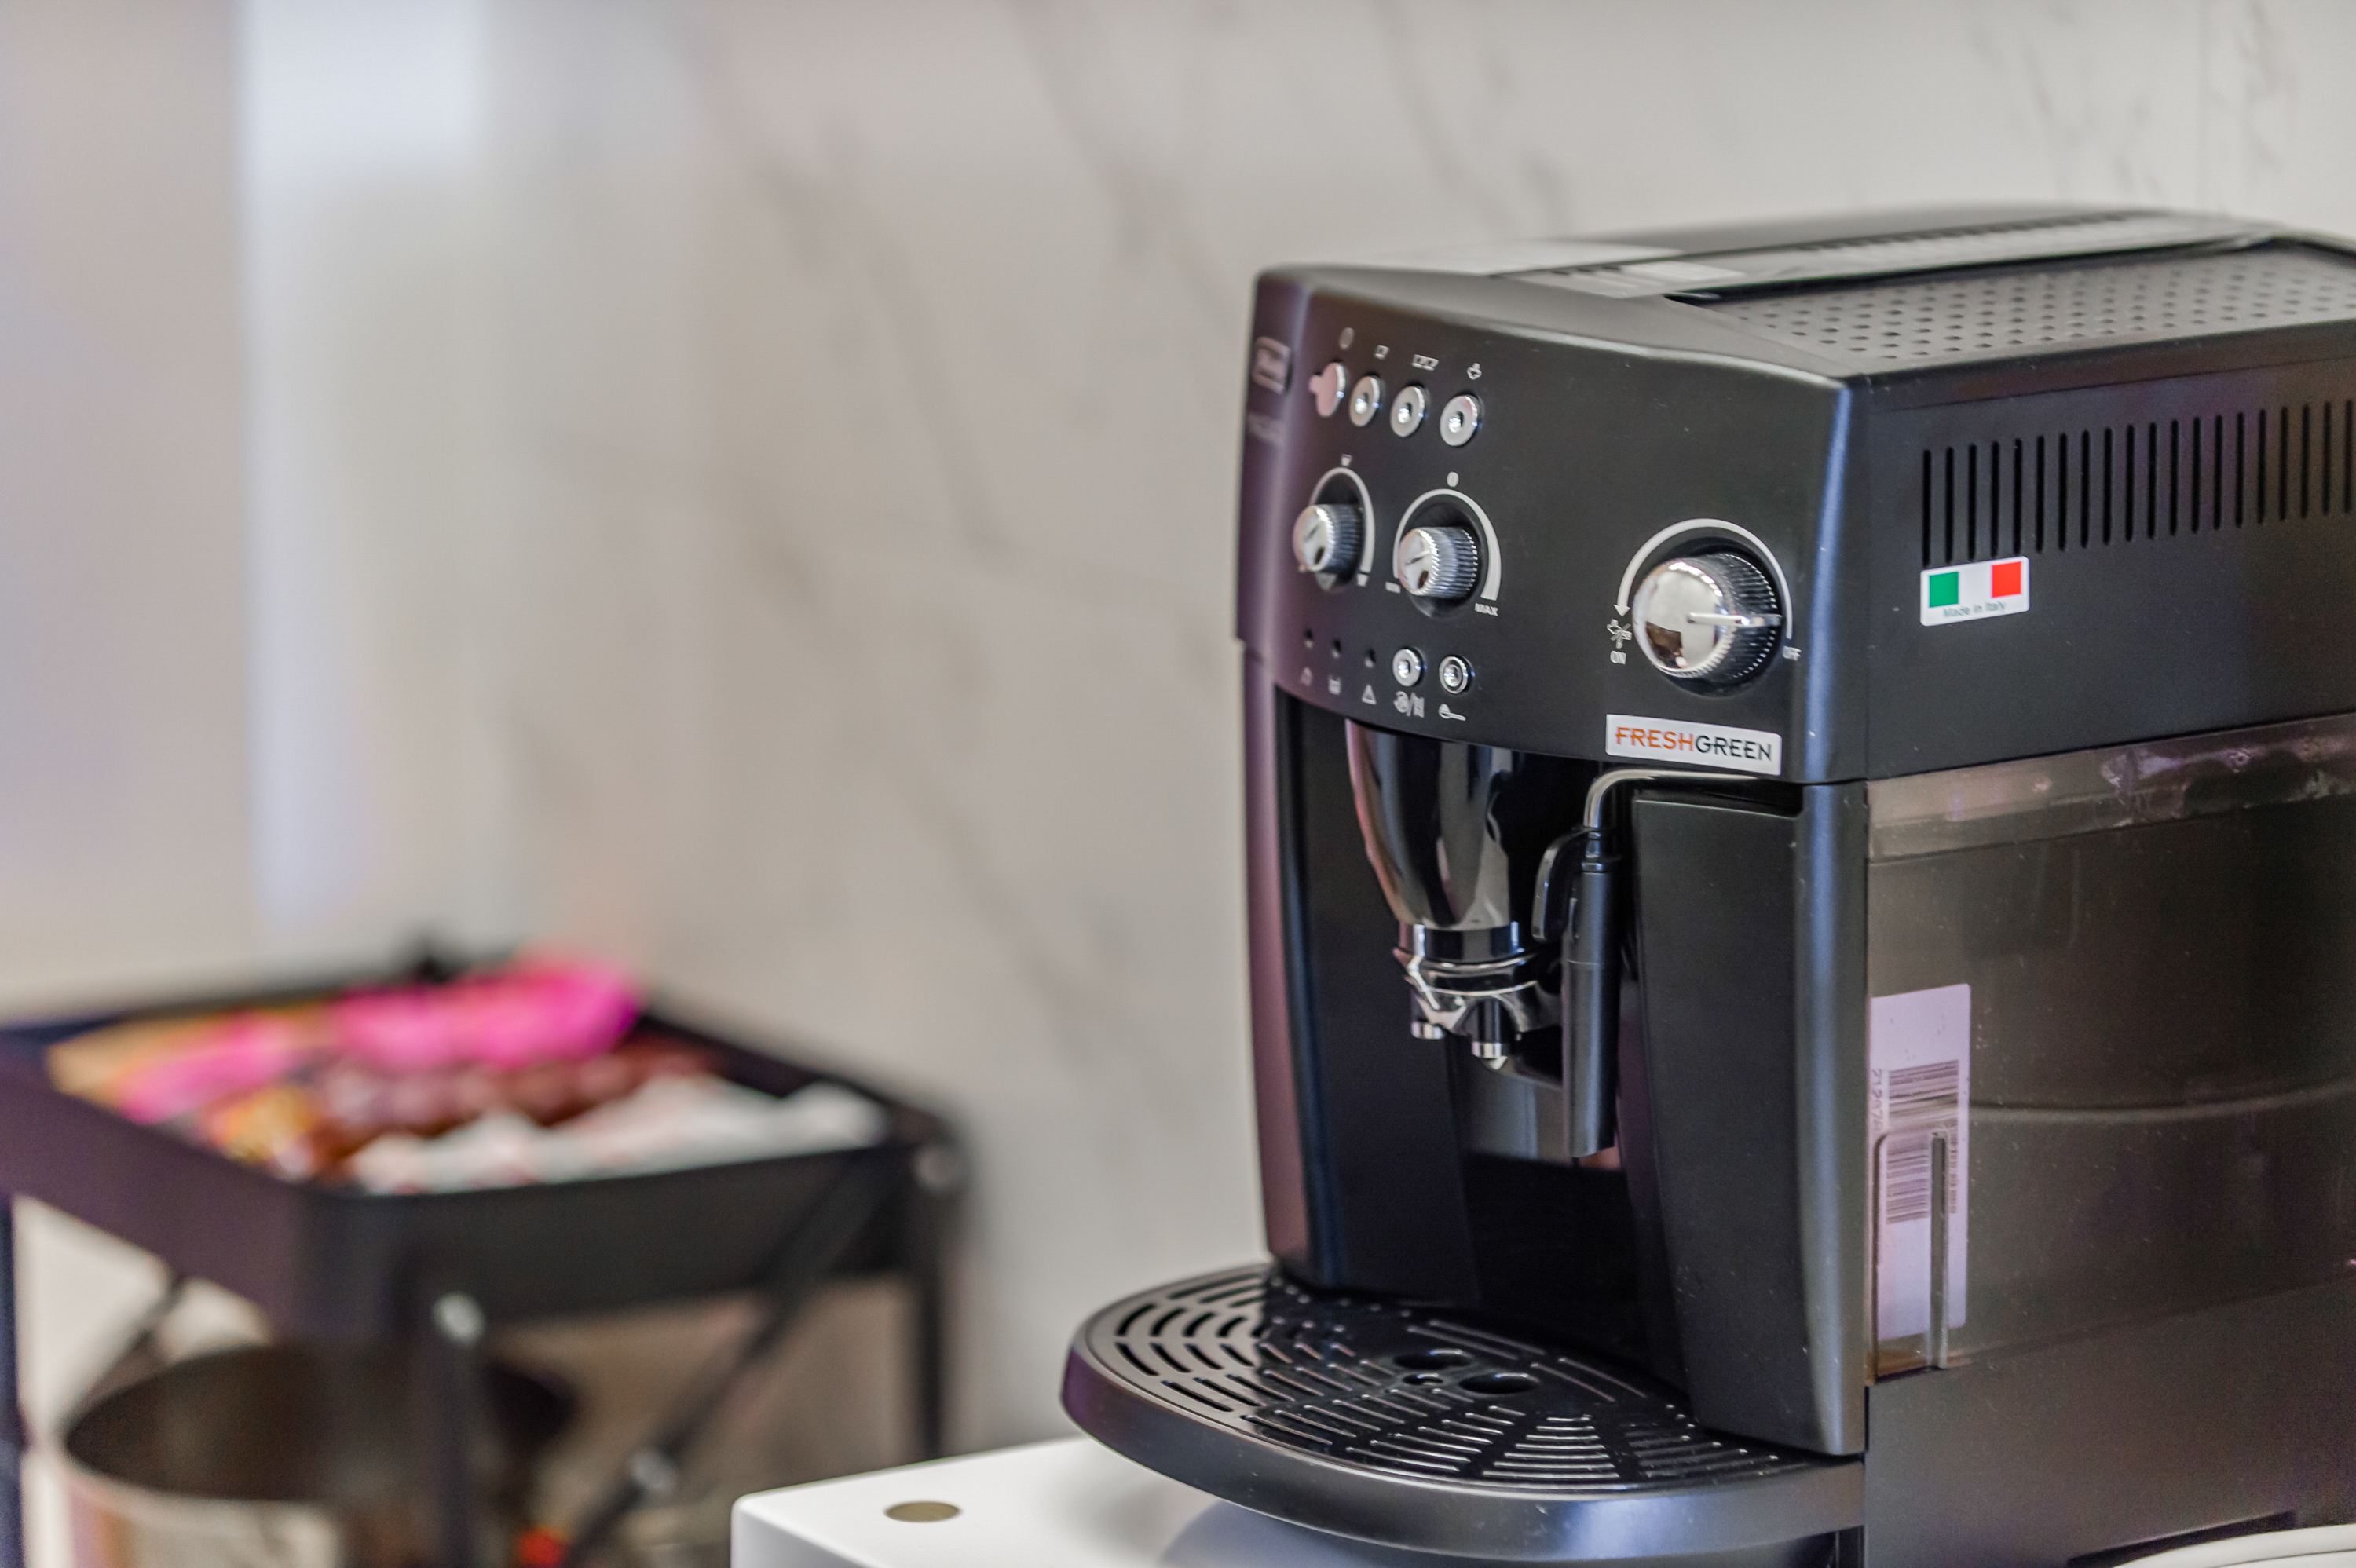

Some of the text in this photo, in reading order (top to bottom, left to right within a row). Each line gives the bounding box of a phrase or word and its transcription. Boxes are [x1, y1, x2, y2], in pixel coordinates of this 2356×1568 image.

[1474, 602, 1499, 617] MAX
[1943, 606, 1970, 618] Made
[1610, 650, 1626, 665] ON
[1783, 645, 1802, 661] OFF
[1615, 726, 1772, 762] FRESHGREEN
